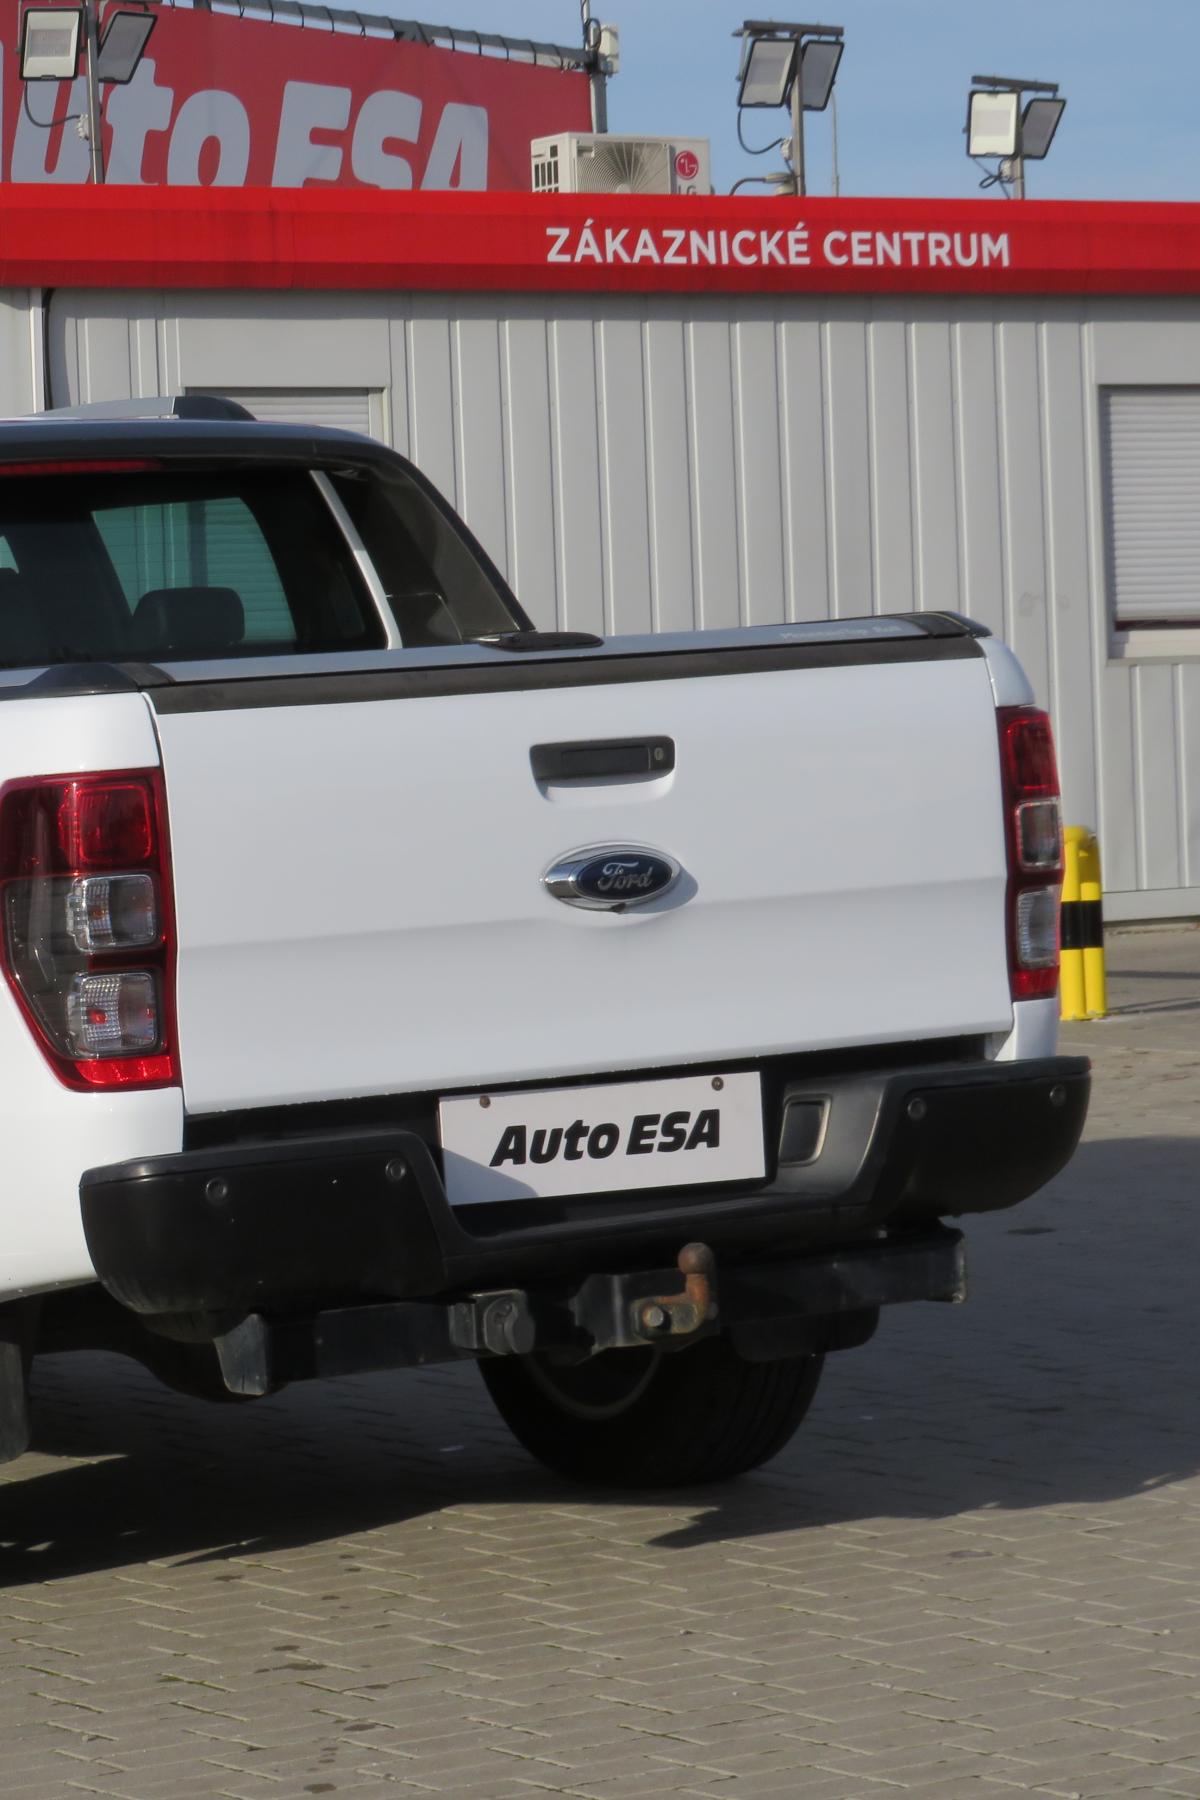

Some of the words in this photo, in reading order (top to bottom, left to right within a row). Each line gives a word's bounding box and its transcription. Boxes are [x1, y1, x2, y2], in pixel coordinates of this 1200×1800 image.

[271, 80, 489, 191] ESA
[546, 218, 811, 265] ZÁKAZNICKÉ
[823, 230, 1010, 267] CENTRUM
[597, 861, 653, 891] Ford
[489, 1119, 620, 1167] Auto
[625, 1109, 720, 1156] ESA
